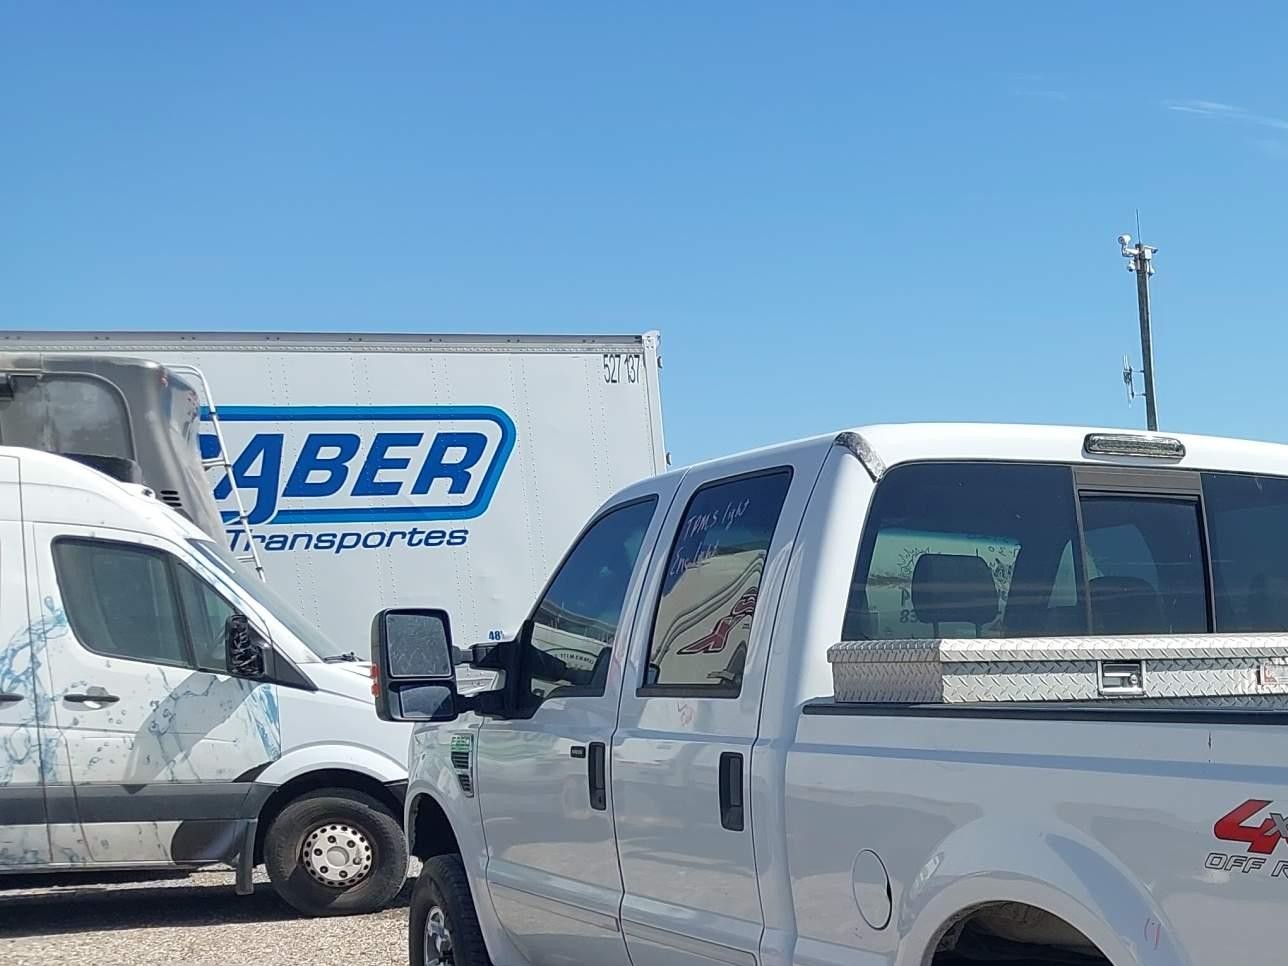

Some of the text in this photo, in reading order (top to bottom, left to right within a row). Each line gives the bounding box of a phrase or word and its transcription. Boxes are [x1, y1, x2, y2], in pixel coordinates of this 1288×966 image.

[603, 354, 640, 384] 527 137
[225, 527, 469, 554] Transportes
[1205, 852, 1267, 874] OFF
